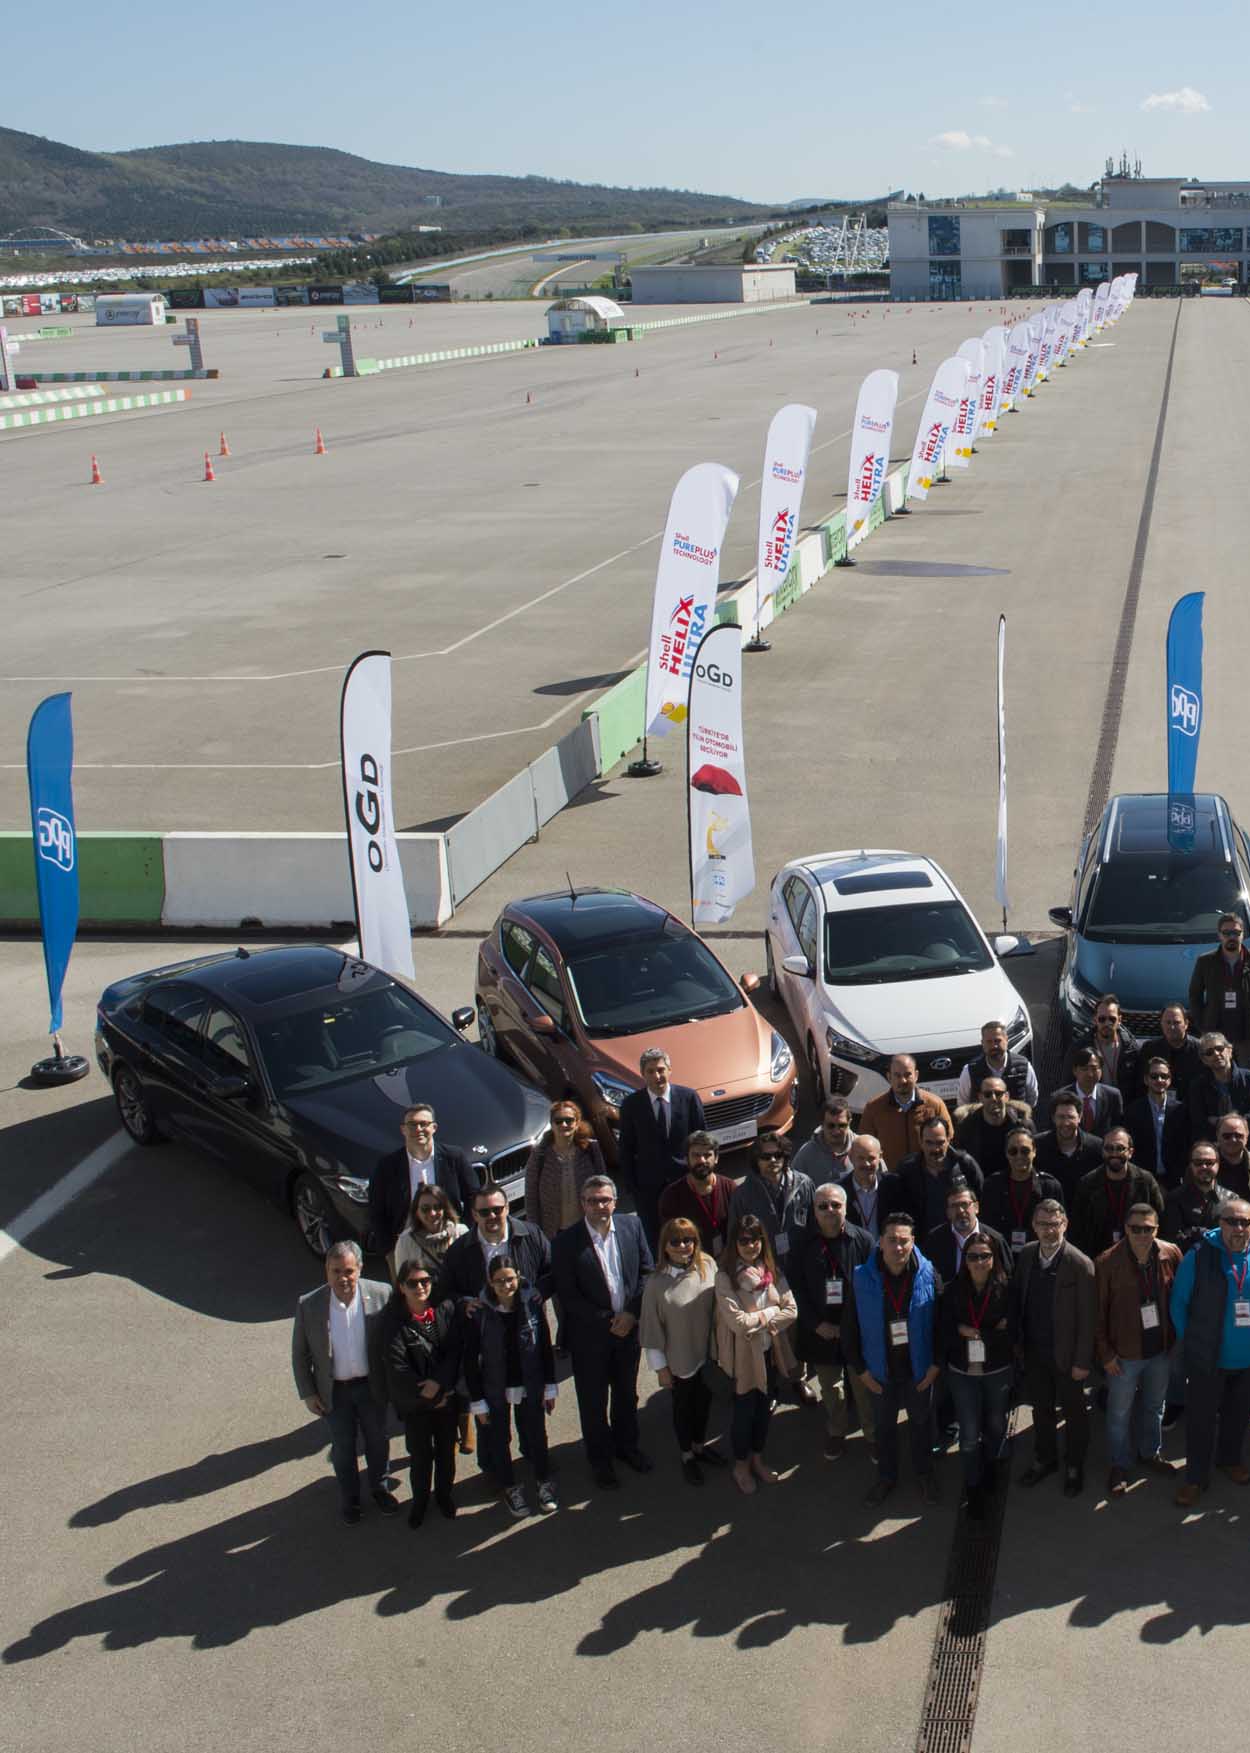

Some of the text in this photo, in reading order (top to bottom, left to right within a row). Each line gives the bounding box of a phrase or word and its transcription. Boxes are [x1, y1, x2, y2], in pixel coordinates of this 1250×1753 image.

[985, 375, 996, 410] HELIX
[1004, 367, 1016, 394] HELIX
[957, 397, 969, 434] HELIX
[965, 400, 977, 434] ULTRA
[924, 422, 942, 463] HELIX
[931, 426, 949, 463] ULTRA
[861, 454, 875, 502] HELIX
[869, 456, 884, 503] ULTRA
[673, 539, 715, 560] PUREPLUS
[673, 548, 713, 566] TECHNOLOGY
[765, 541, 773, 568] Shell
[773, 510, 789, 571] HELIX
[659, 634, 672, 670] Shell
[669, 595, 695, 676] HELIX
